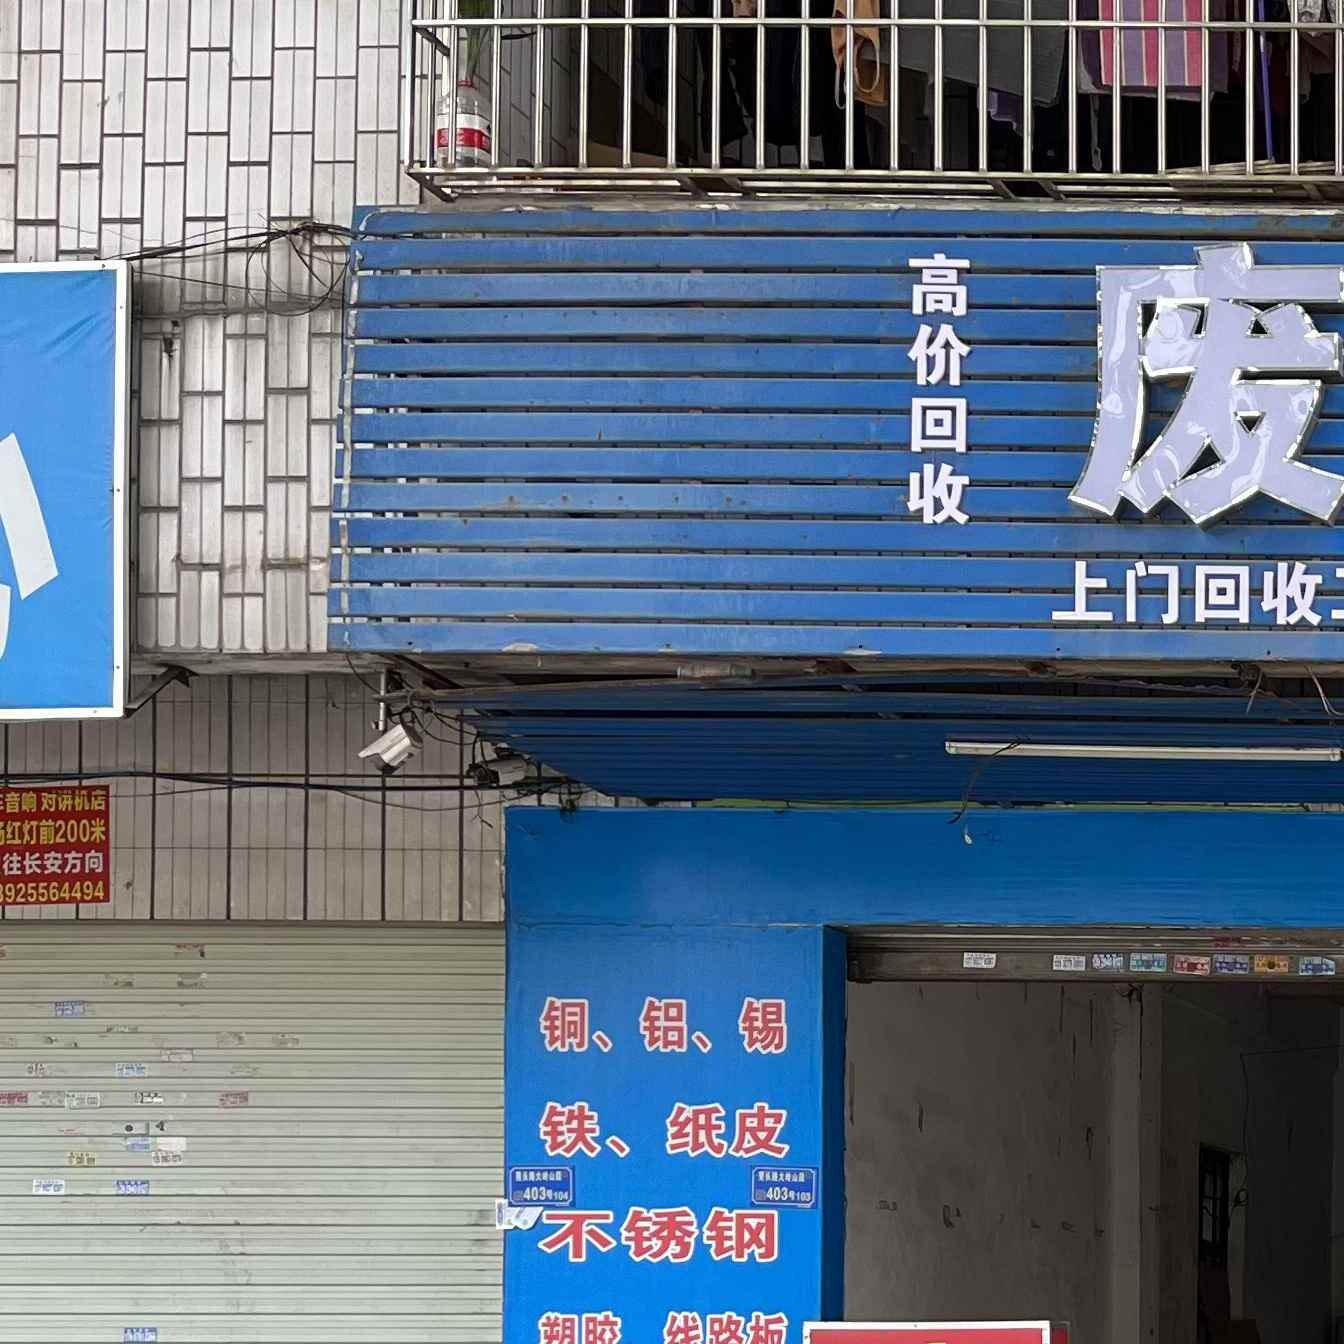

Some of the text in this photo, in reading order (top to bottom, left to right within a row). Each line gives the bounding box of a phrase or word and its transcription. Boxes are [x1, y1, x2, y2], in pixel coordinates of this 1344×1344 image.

[907, 253, 970, 525] 高价回收
[0, 791, 36, 813] 音响
[3, 850, 104, 875] 往长安方向
[540, 1102, 790, 1158] 铁、纸皮
[539, 1206, 779, 1263] 不锈钢
